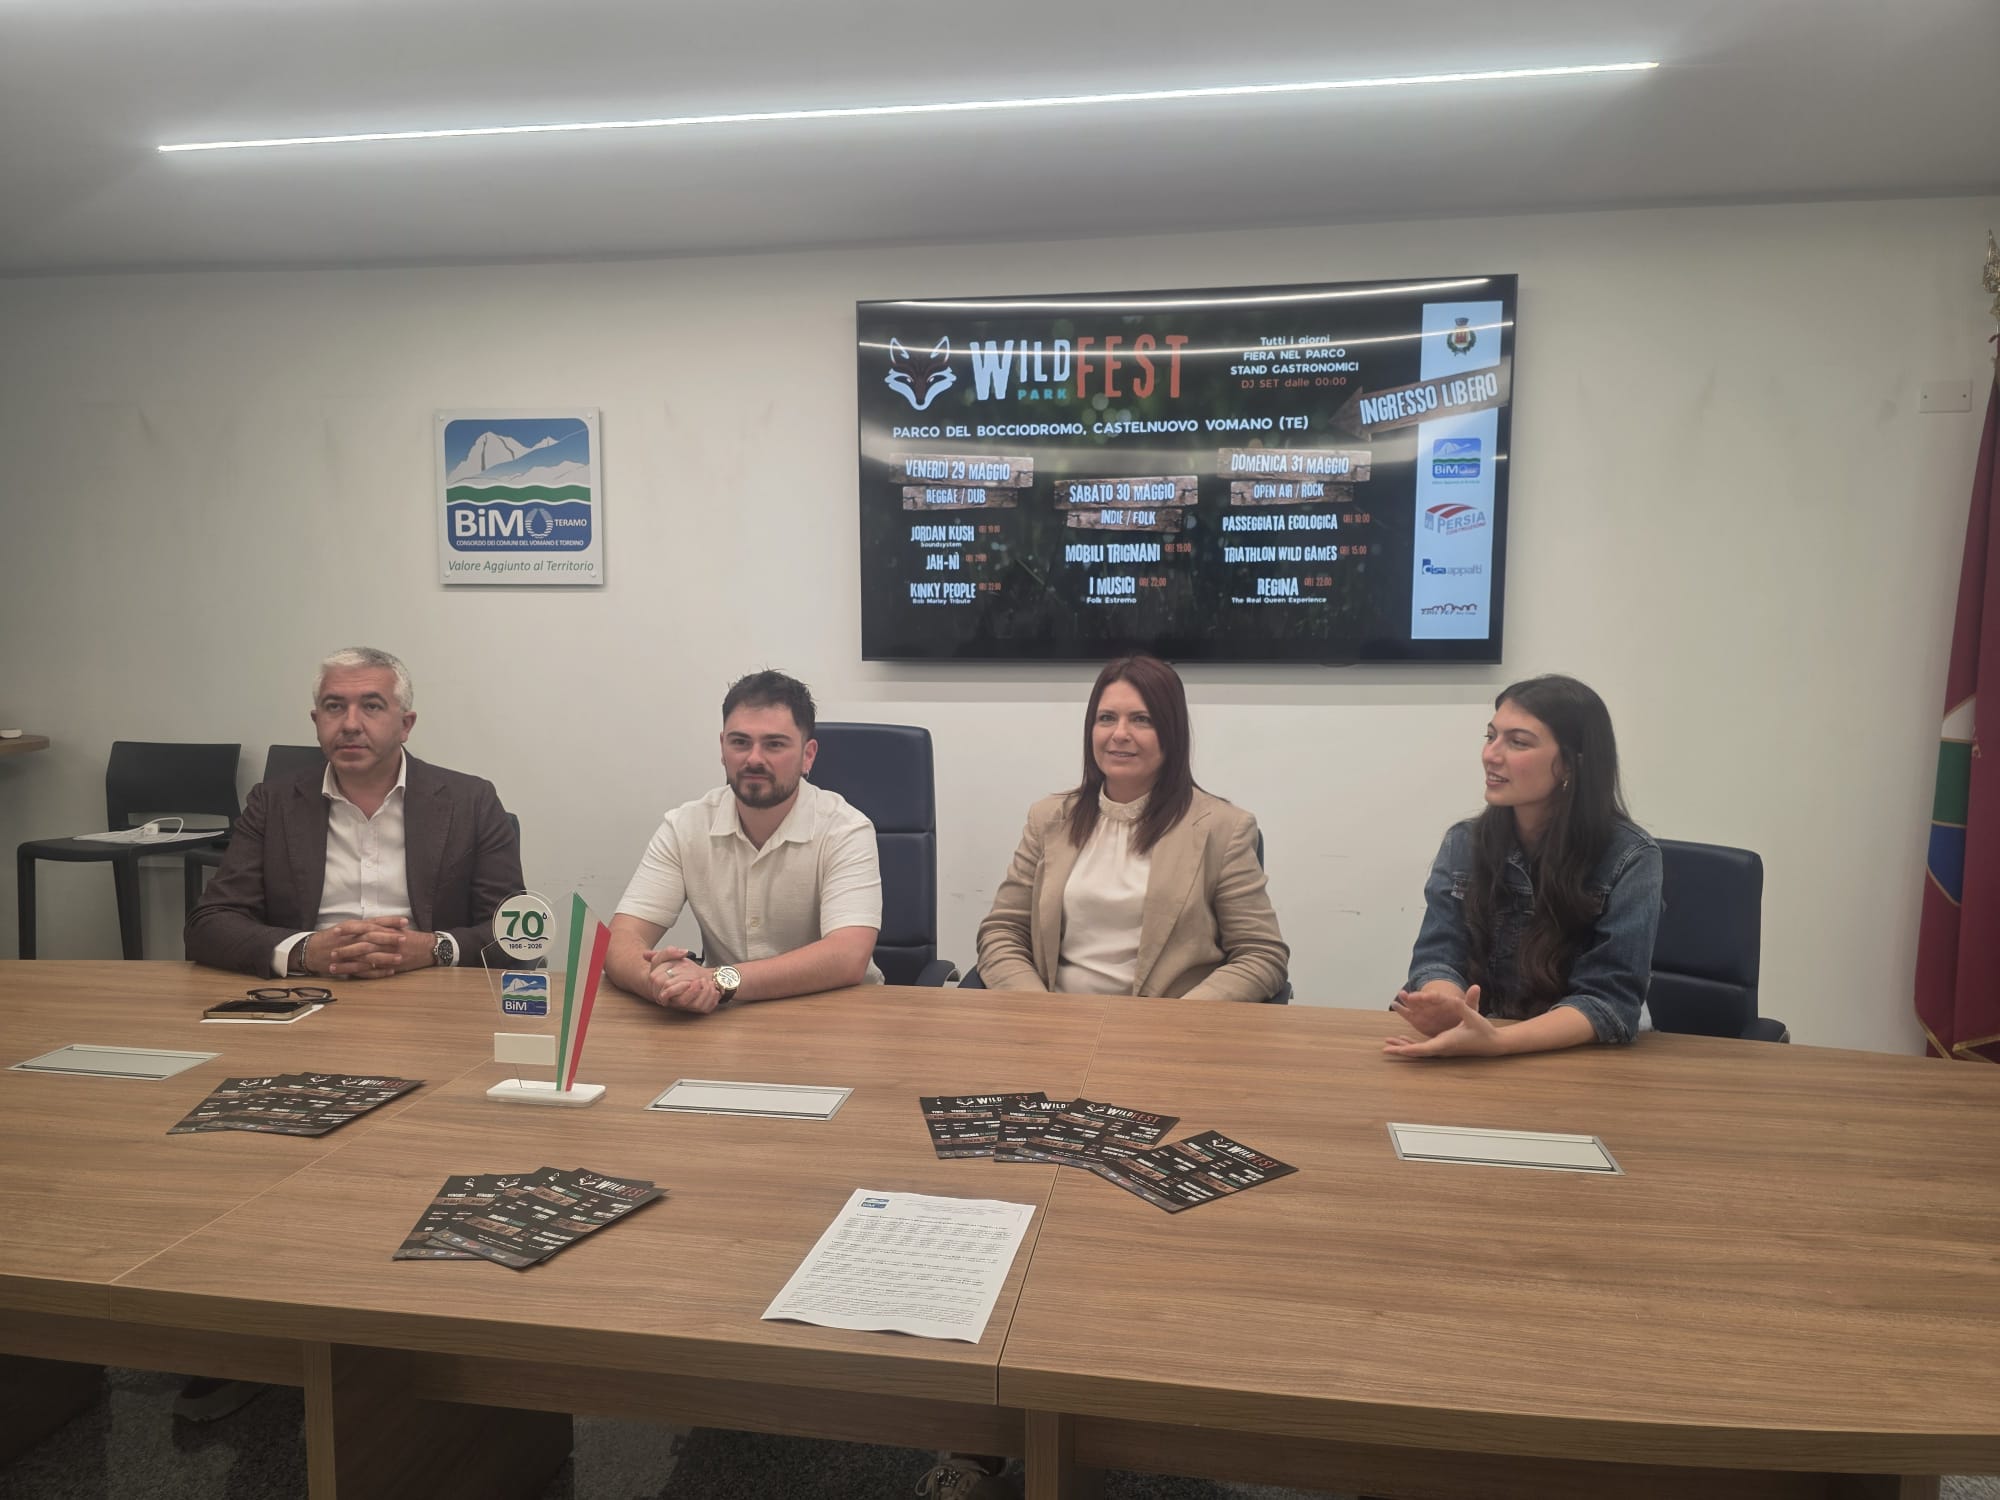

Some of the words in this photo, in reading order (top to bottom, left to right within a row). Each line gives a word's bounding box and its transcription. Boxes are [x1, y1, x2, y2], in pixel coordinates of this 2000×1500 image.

[1260, 336, 1285, 346] Tutti
[1298, 334, 1330, 347] giorni
[1243, 351, 1275, 360] FIERA
[1280, 350, 1301, 360] NEL
[1306, 348, 1346, 359] PARCO
[1230, 365, 1267, 375] STAND
[1272, 362, 1359, 374] GASTRONOMICI
[1241, 380, 1255, 389] DJ
[1260, 379, 1279, 388] SET
[1285, 378, 1310, 387] dalle
[1315, 377, 1347, 386] 00:00
[1018, 388, 1067, 400] PARK
[1359, 385, 1438, 425] INGRESSO
[1441, 372, 1498, 408] LIBERO
[893, 426, 940, 438] PARCO
[946, 425, 971, 437] DEL
[977, 423, 1087, 437] BOCCIODROMO,
[1093, 420, 1198, 434] CASTELNUOVO
[1205, 418, 1273, 431] VOMANO
[1279, 416, 1309, 431] (TE)
[905, 459, 948, 479] VENERDÌ
[951, 461, 965, 480] 29
[968, 462, 1010, 481] MAGGIO
[1231, 454, 1287, 472] DOMENICA
[1291, 455, 1304, 473] 31
[1306, 456, 1349, 474] MAGGIO
[1434, 465, 1458, 474] BiM
[926, 488, 958, 503] REGGAE
[967, 488, 986, 503] DUB
[1069, 484, 1113, 503] SABATO
[1116, 483, 1130, 501] 30
[1133, 483, 1175, 501] MAGGIO
[1254, 484, 1276, 498] OPEN
[1279, 484, 1293, 498] AIR
[1301, 483, 1324, 498] ROCK
[455, 509, 524, 536] BiM
[554, 519, 588, 527] TERAMO
[1101, 509, 1123, 525] INDIE
[1133, 511, 1156, 525] FOLK
[1222, 515, 1285, 532] PASSEGGIATA
[1288, 513, 1338, 530] ECOLOGICA
[1437, 511, 1486, 533] PERSIA
[910, 526, 946, 542] JORDAN
[948, 525, 975, 542] KUSH
[1065, 544, 1104, 563] MOBILI
[1107, 543, 1161, 563] TRIGNANI
[1224, 546, 1276, 563] TRIATHLON
[1278, 546, 1301, 562] WILD
[1304, 545, 1338, 562] GAMES
[449, 561, 481, 571] Valore
[483, 560, 530, 573] Aggiunto
[534, 561, 543, 571] al
[546, 561, 594, 571] Territorio
[910, 582, 941, 598] KINKY
[943, 583, 976, 599] PEOPLE
[1089, 577, 1094, 595] I
[1097, 576, 1135, 595] MUSICI
[1257, 577, 1299, 596] REGINA
[505, 1000, 527, 1011] BiM
